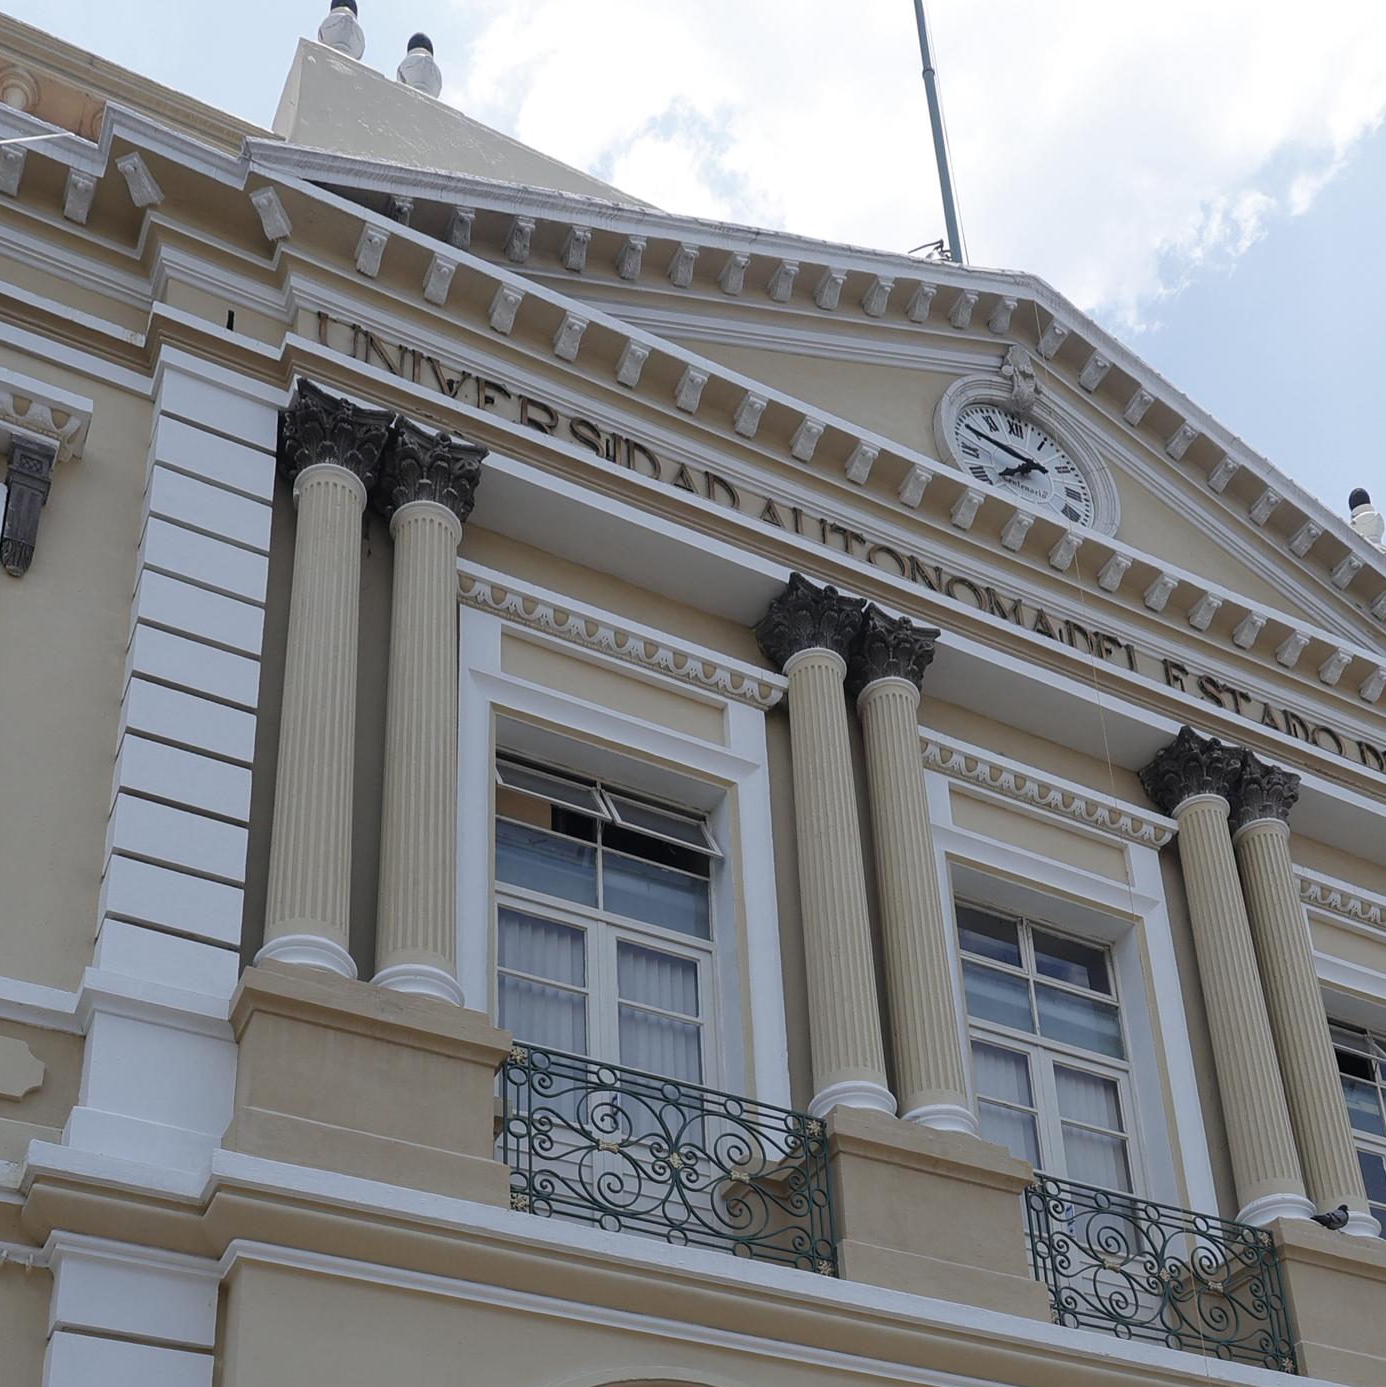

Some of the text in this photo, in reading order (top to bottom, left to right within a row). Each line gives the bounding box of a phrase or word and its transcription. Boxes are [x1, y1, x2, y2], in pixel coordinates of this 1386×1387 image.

[317, 309, 743, 511] UNIVERSIDAD
[759, 497, 1056, 640] AUTONOMA
[1059, 617, 1139, 673] DEL
[1162, 655, 1348, 758] ESTADO
